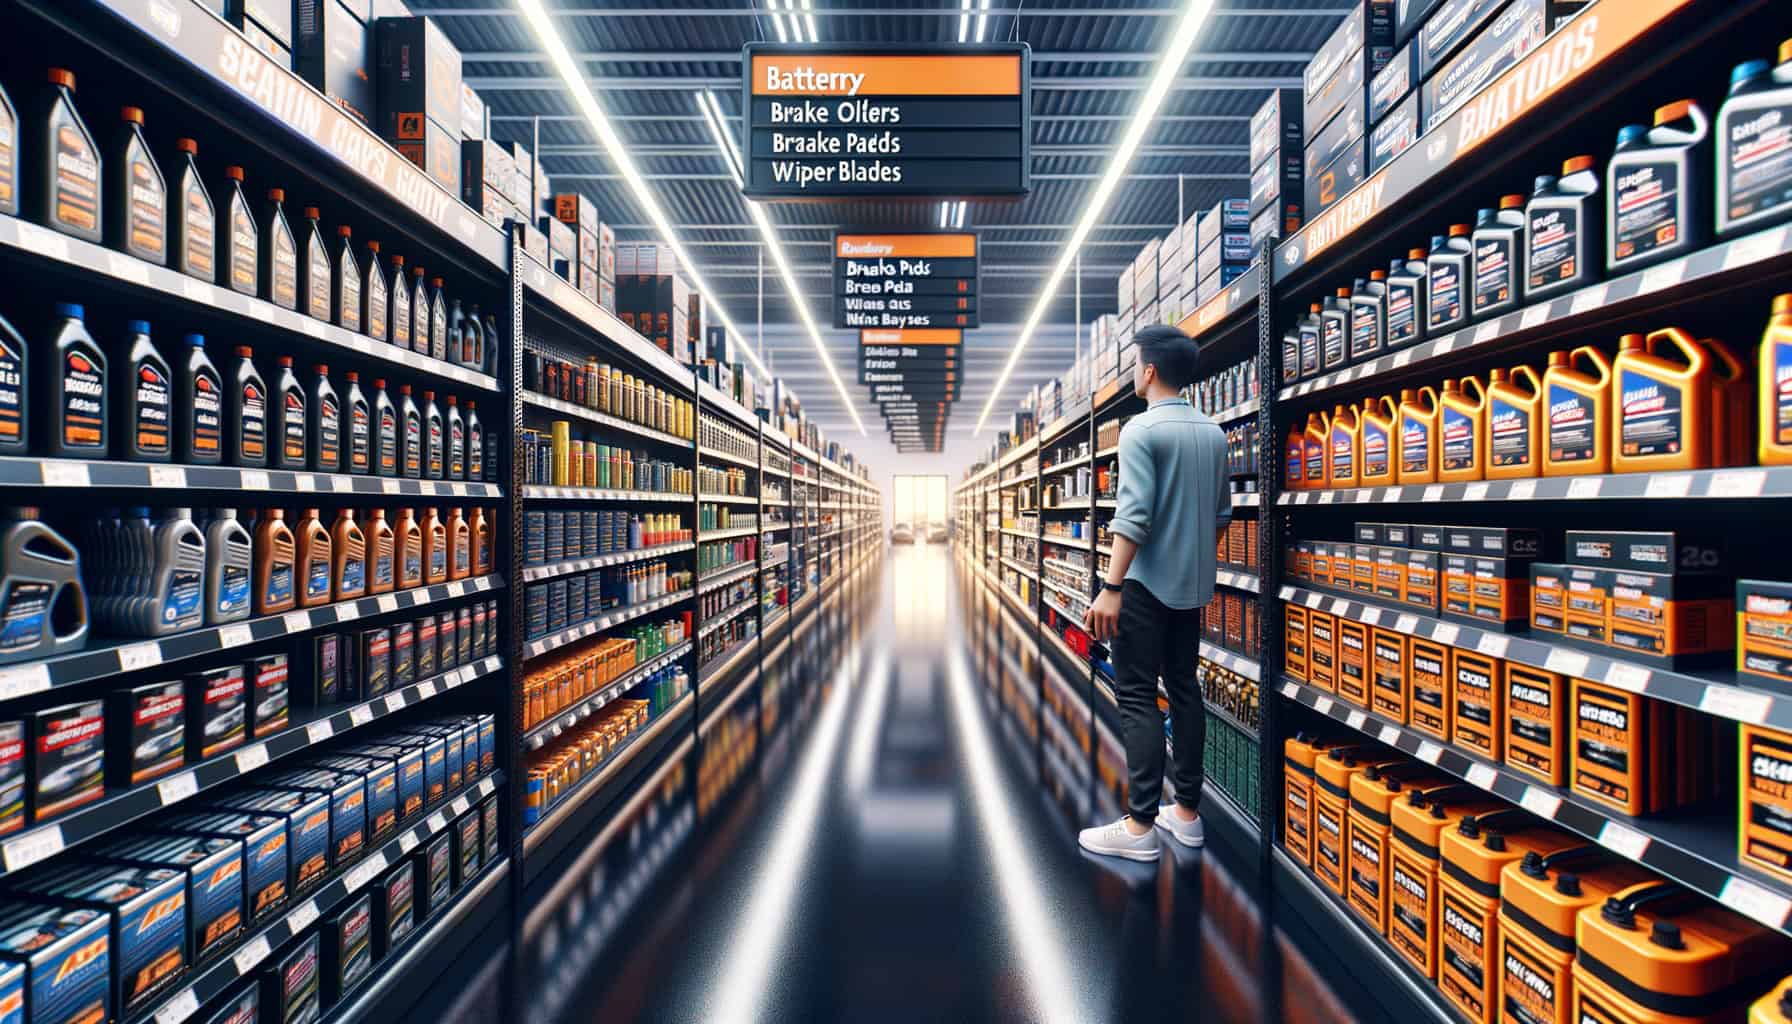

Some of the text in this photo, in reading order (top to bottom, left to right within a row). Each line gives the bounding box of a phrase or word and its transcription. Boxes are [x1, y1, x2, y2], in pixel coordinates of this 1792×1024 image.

[771, 100, 829, 123] Brake
[773, 130, 841, 153] Braake
[772, 160, 902, 188] Wiper Blades
